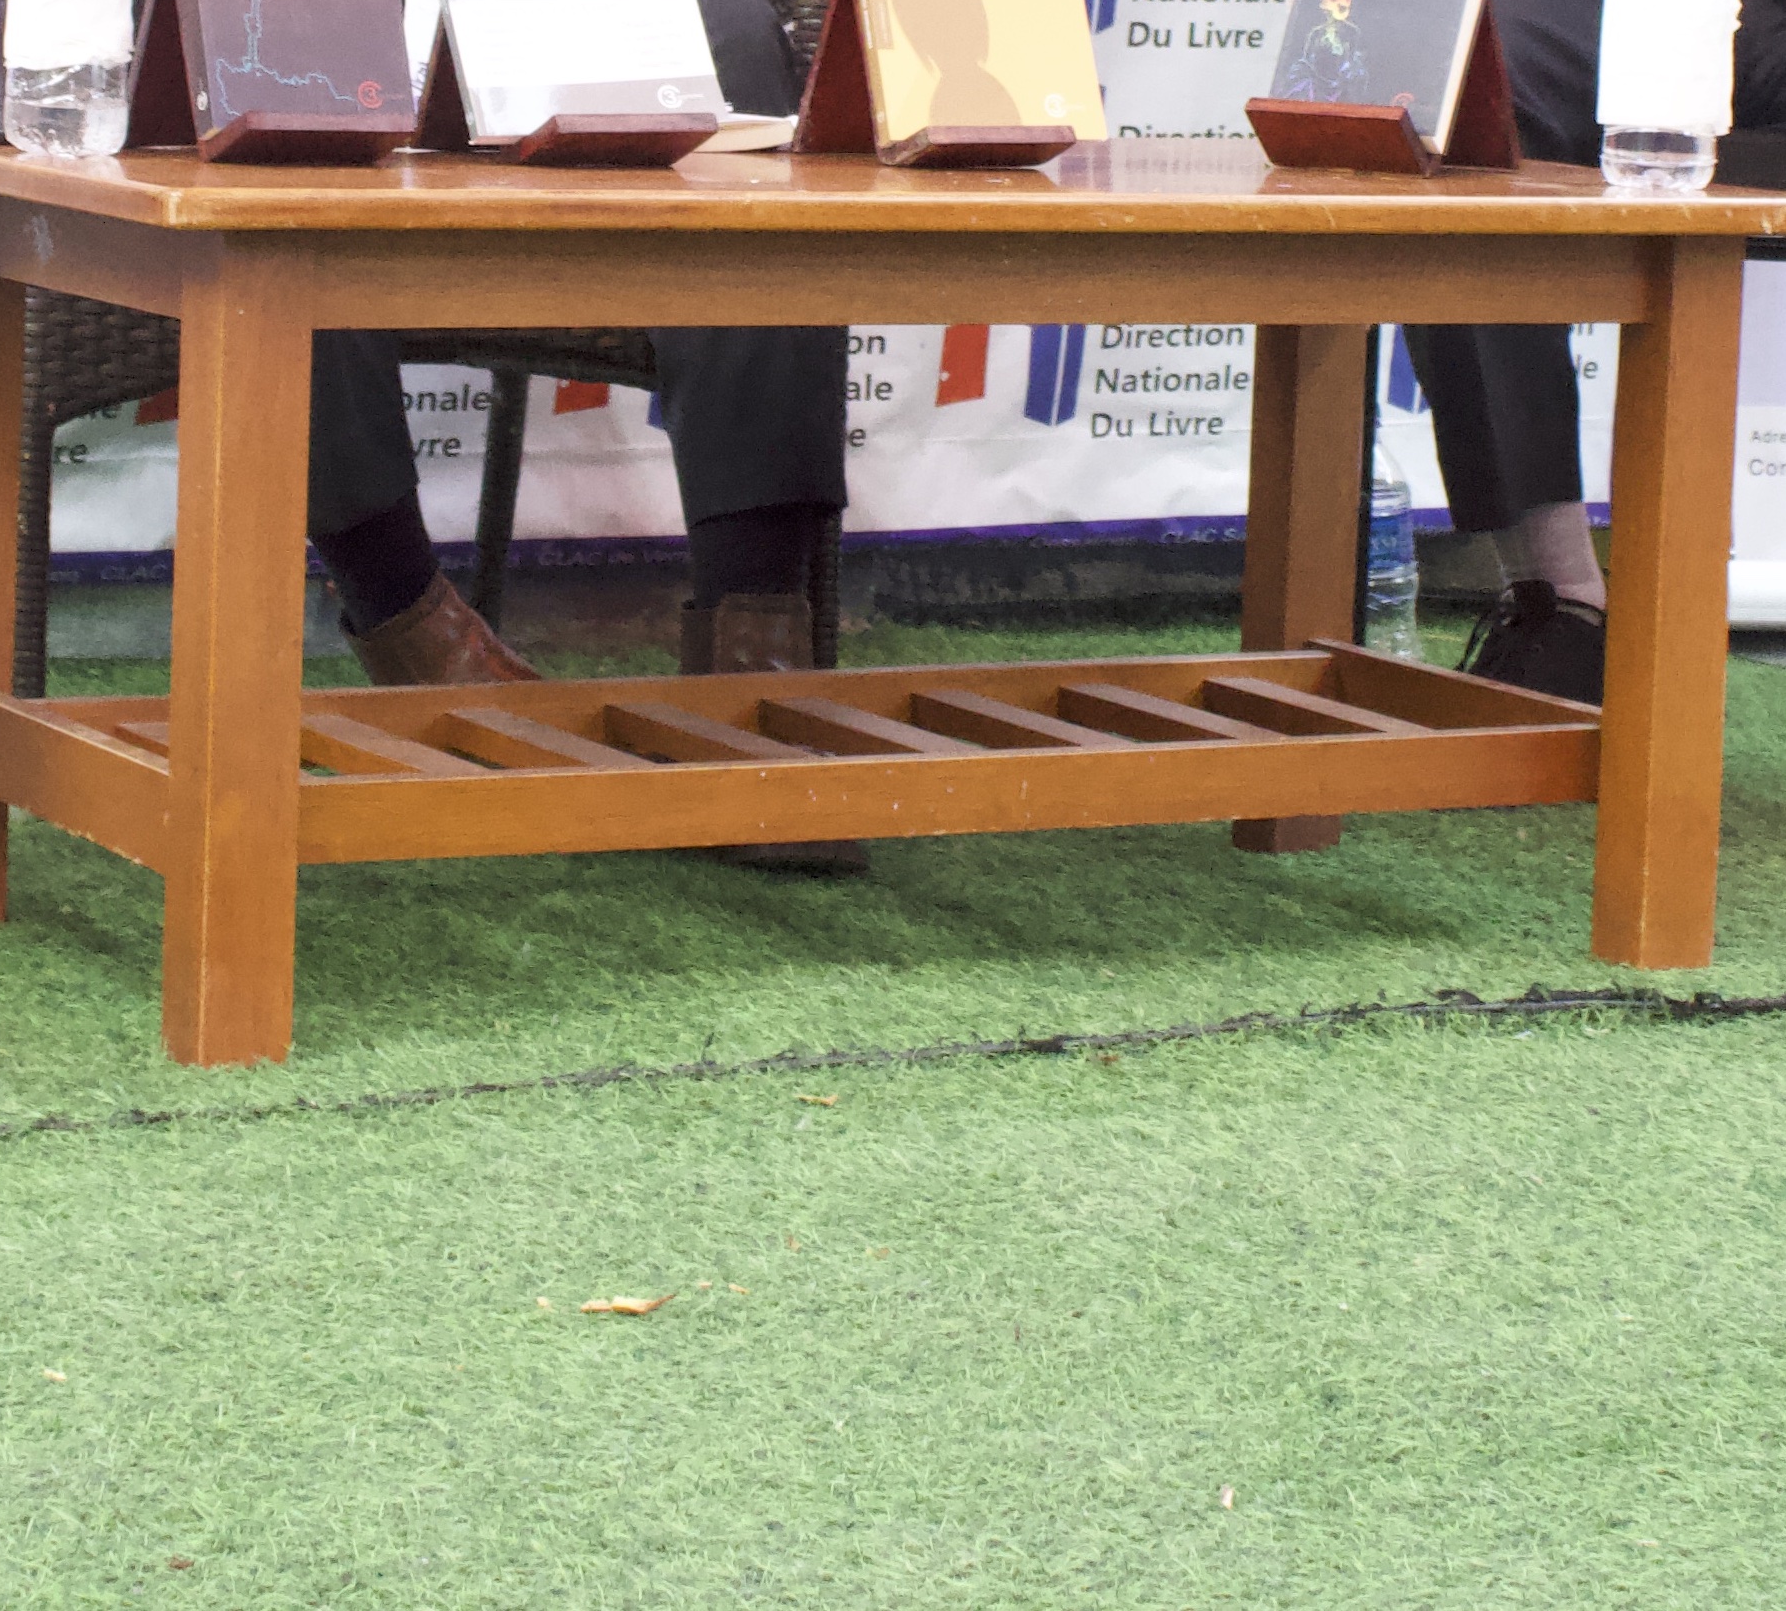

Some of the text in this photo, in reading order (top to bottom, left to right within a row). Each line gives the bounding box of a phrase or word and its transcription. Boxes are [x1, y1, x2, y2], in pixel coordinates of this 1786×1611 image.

[1126, 20, 1265, 49] Du Livre
[1100, 323, 1245, 349] Direction
[1094, 363, 1251, 395] Nationale
[1090, 409, 1225, 439] Du Livre
